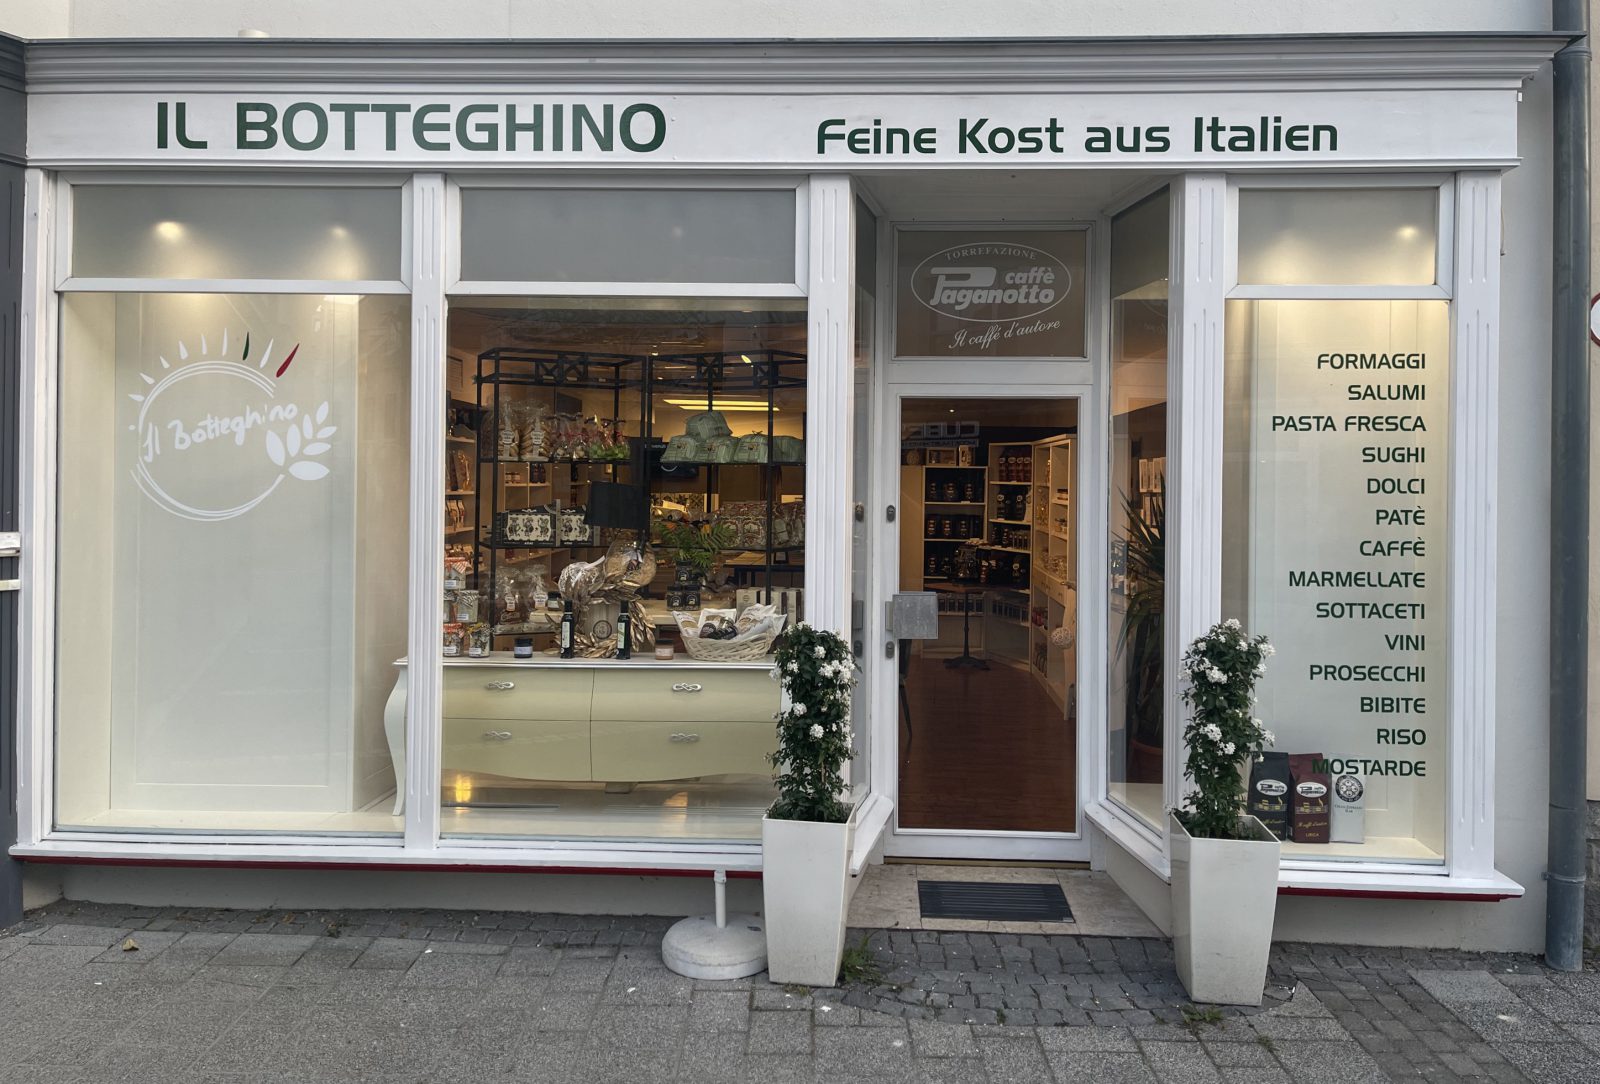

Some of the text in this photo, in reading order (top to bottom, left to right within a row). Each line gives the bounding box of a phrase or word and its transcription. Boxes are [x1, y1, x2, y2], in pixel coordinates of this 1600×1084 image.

[158, 103, 666, 152] IL BOTTEGHINO
[818, 117, 1337, 154] Feine Kost aus Italien
[945, 247, 1037, 261] TORREFAZIONE
[1005, 267, 1055, 284] caffè
[930, 267, 1055, 310] Paganotto
[948, 329, 968, 348] Il
[1318, 354, 1425, 369] FORMAGGI
[1348, 385, 1425, 400] SALUMI
[168, 403, 298, 450] Botteghino
[1272, 416, 1426, 431] PASTA FRESCA
[1362, 447, 1425, 462] SUGHI
[1368, 478, 1424, 494] DOLCI
[1376, 506, 1425, 525] PATÈ
[1360, 537, 1425, 556] CAFFÈ
[1290, 571, 1425, 588] MARMELLATE
[1316, 602, 1425, 619] SOTTACETI
[1385, 635, 1425, 651] VINI
[1310, 665, 1425, 682] PROSECCHI
[1361, 697, 1425, 713] BIBITE
[1377, 729, 1426, 745] RISO
[1312, 758, 1426, 776] MOSTARDE
